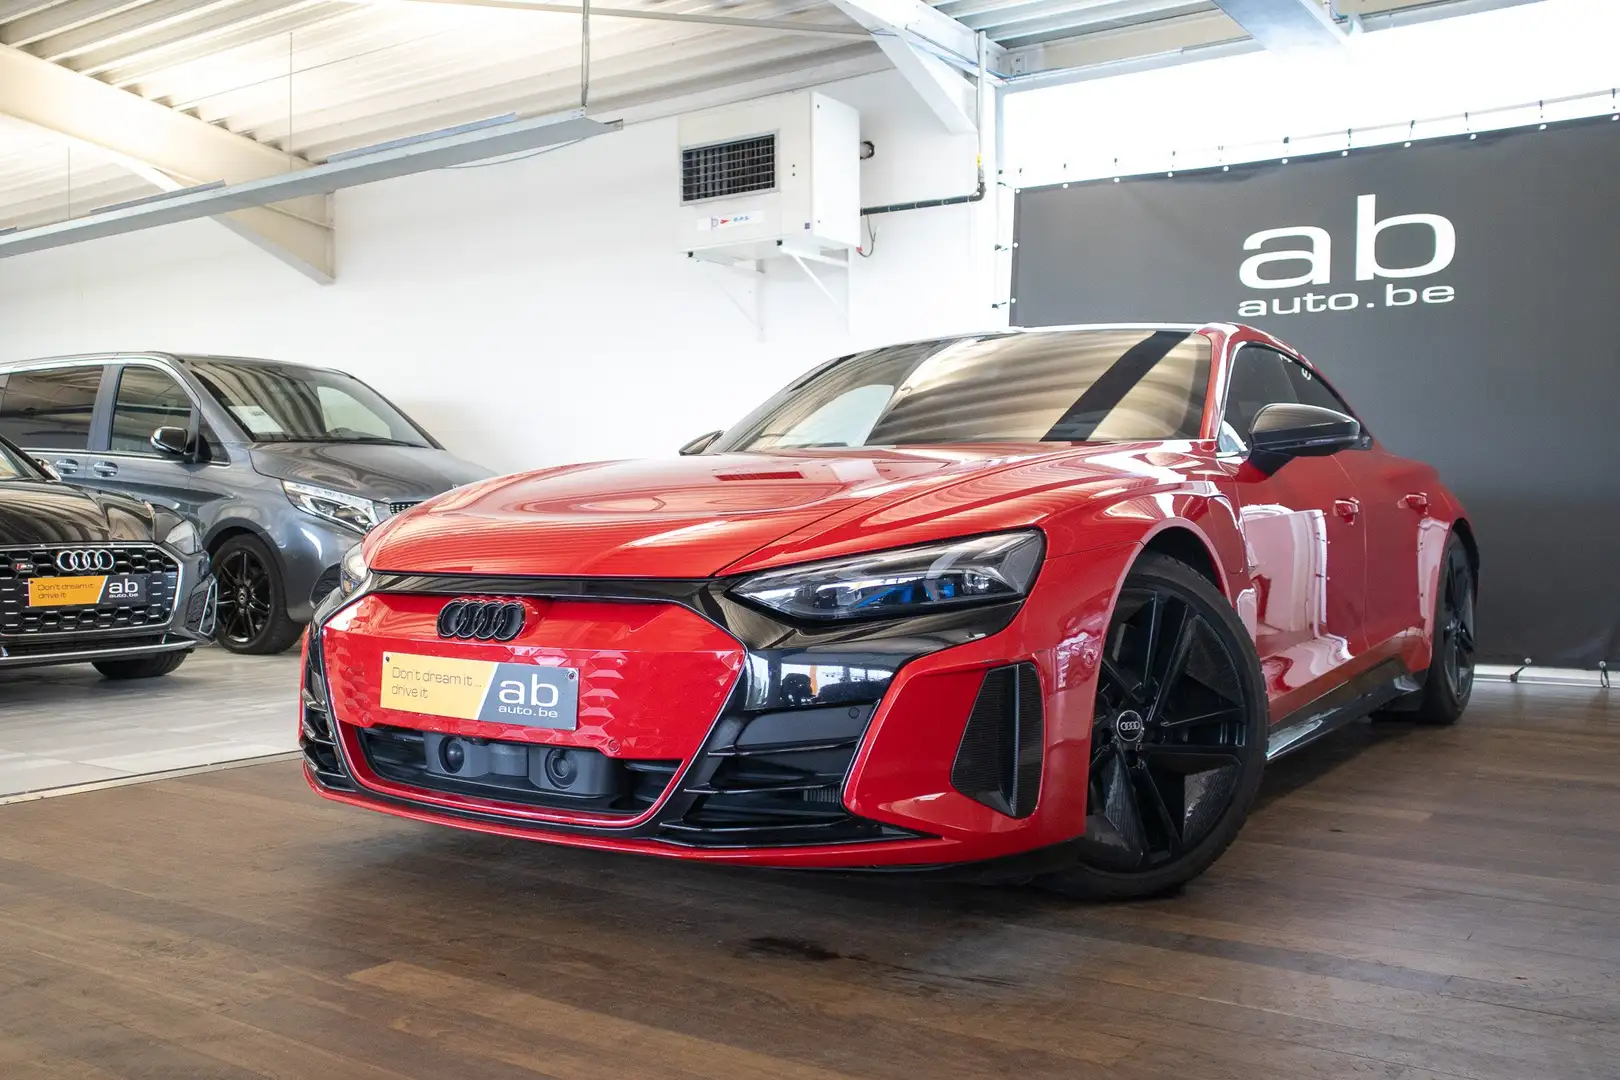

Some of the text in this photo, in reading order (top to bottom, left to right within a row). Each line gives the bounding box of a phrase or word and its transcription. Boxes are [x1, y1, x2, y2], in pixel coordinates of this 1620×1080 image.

[1239, 194, 1455, 289] ab
[1238, 284, 1455, 316] auto.be
[61, 582, 88, 590] dream
[109, 578, 139, 594] ab
[392, 667, 421, 681] Don't
[422, 671, 461, 685] dream
[463, 673, 473, 687] it
[391, 684, 429, 699] drive it
[499, 674, 559, 707] ab
[498, 705, 558, 718] auto.be
